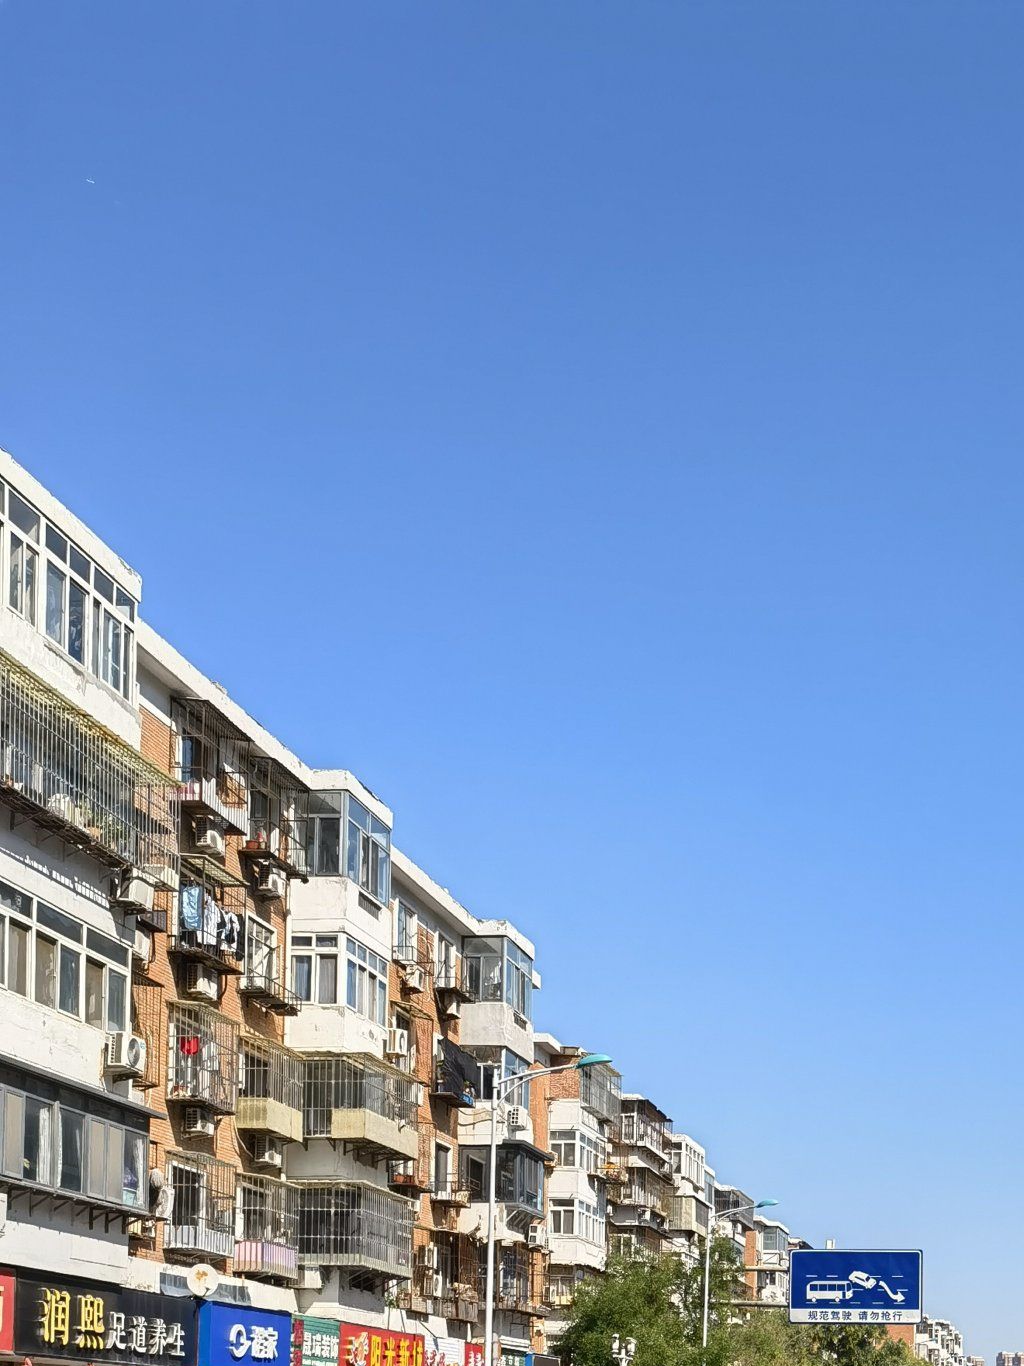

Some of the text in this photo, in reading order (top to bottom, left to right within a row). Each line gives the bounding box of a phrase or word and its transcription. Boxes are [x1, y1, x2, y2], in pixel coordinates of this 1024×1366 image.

[36, 1287, 186, 1357] 润熙足道养生
[808, 1311, 903, 1321] 规范驾驶 请勿抢行
